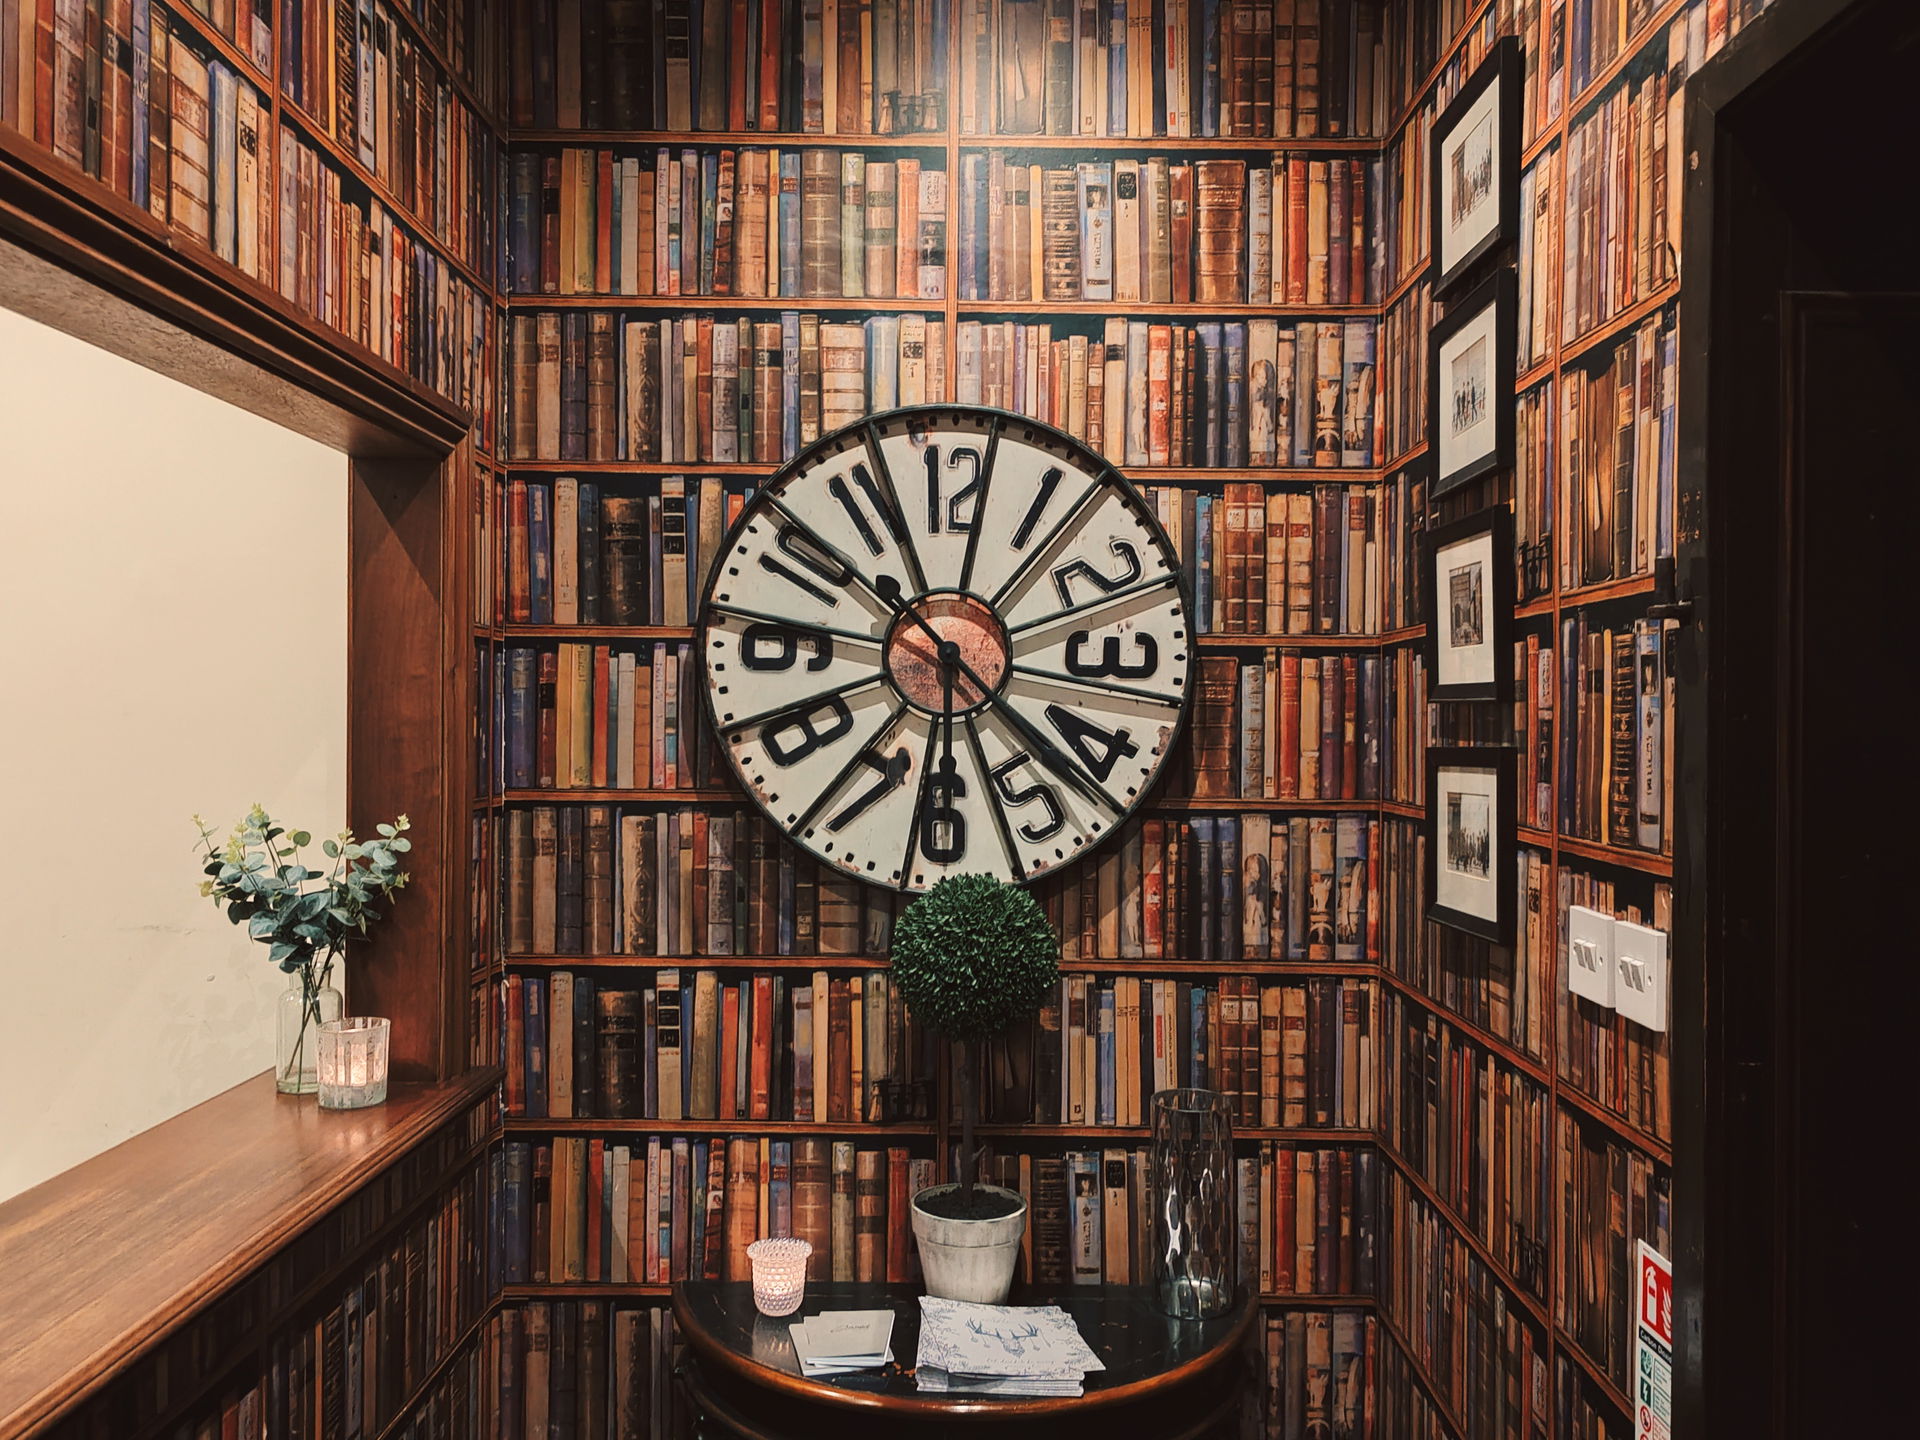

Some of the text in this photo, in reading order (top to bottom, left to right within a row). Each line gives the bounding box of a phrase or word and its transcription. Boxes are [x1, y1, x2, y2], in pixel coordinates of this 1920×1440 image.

[829, 463, 904, 557] 11
[924, 445, 983, 535] 12
[1011, 466, 1064, 551] 1
[759, 524, 854, 608] 10
[1051, 537, 1145, 609] 2
[741, 624, 833, 672] 9
[1065, 630, 1158, 679] 3
[760, 695, 853, 767] 8
[1045, 704, 1140, 783] 4
[825, 747, 911, 834] 7
[920, 771, 966, 865] 6
[990, 751, 1066, 844] 5
